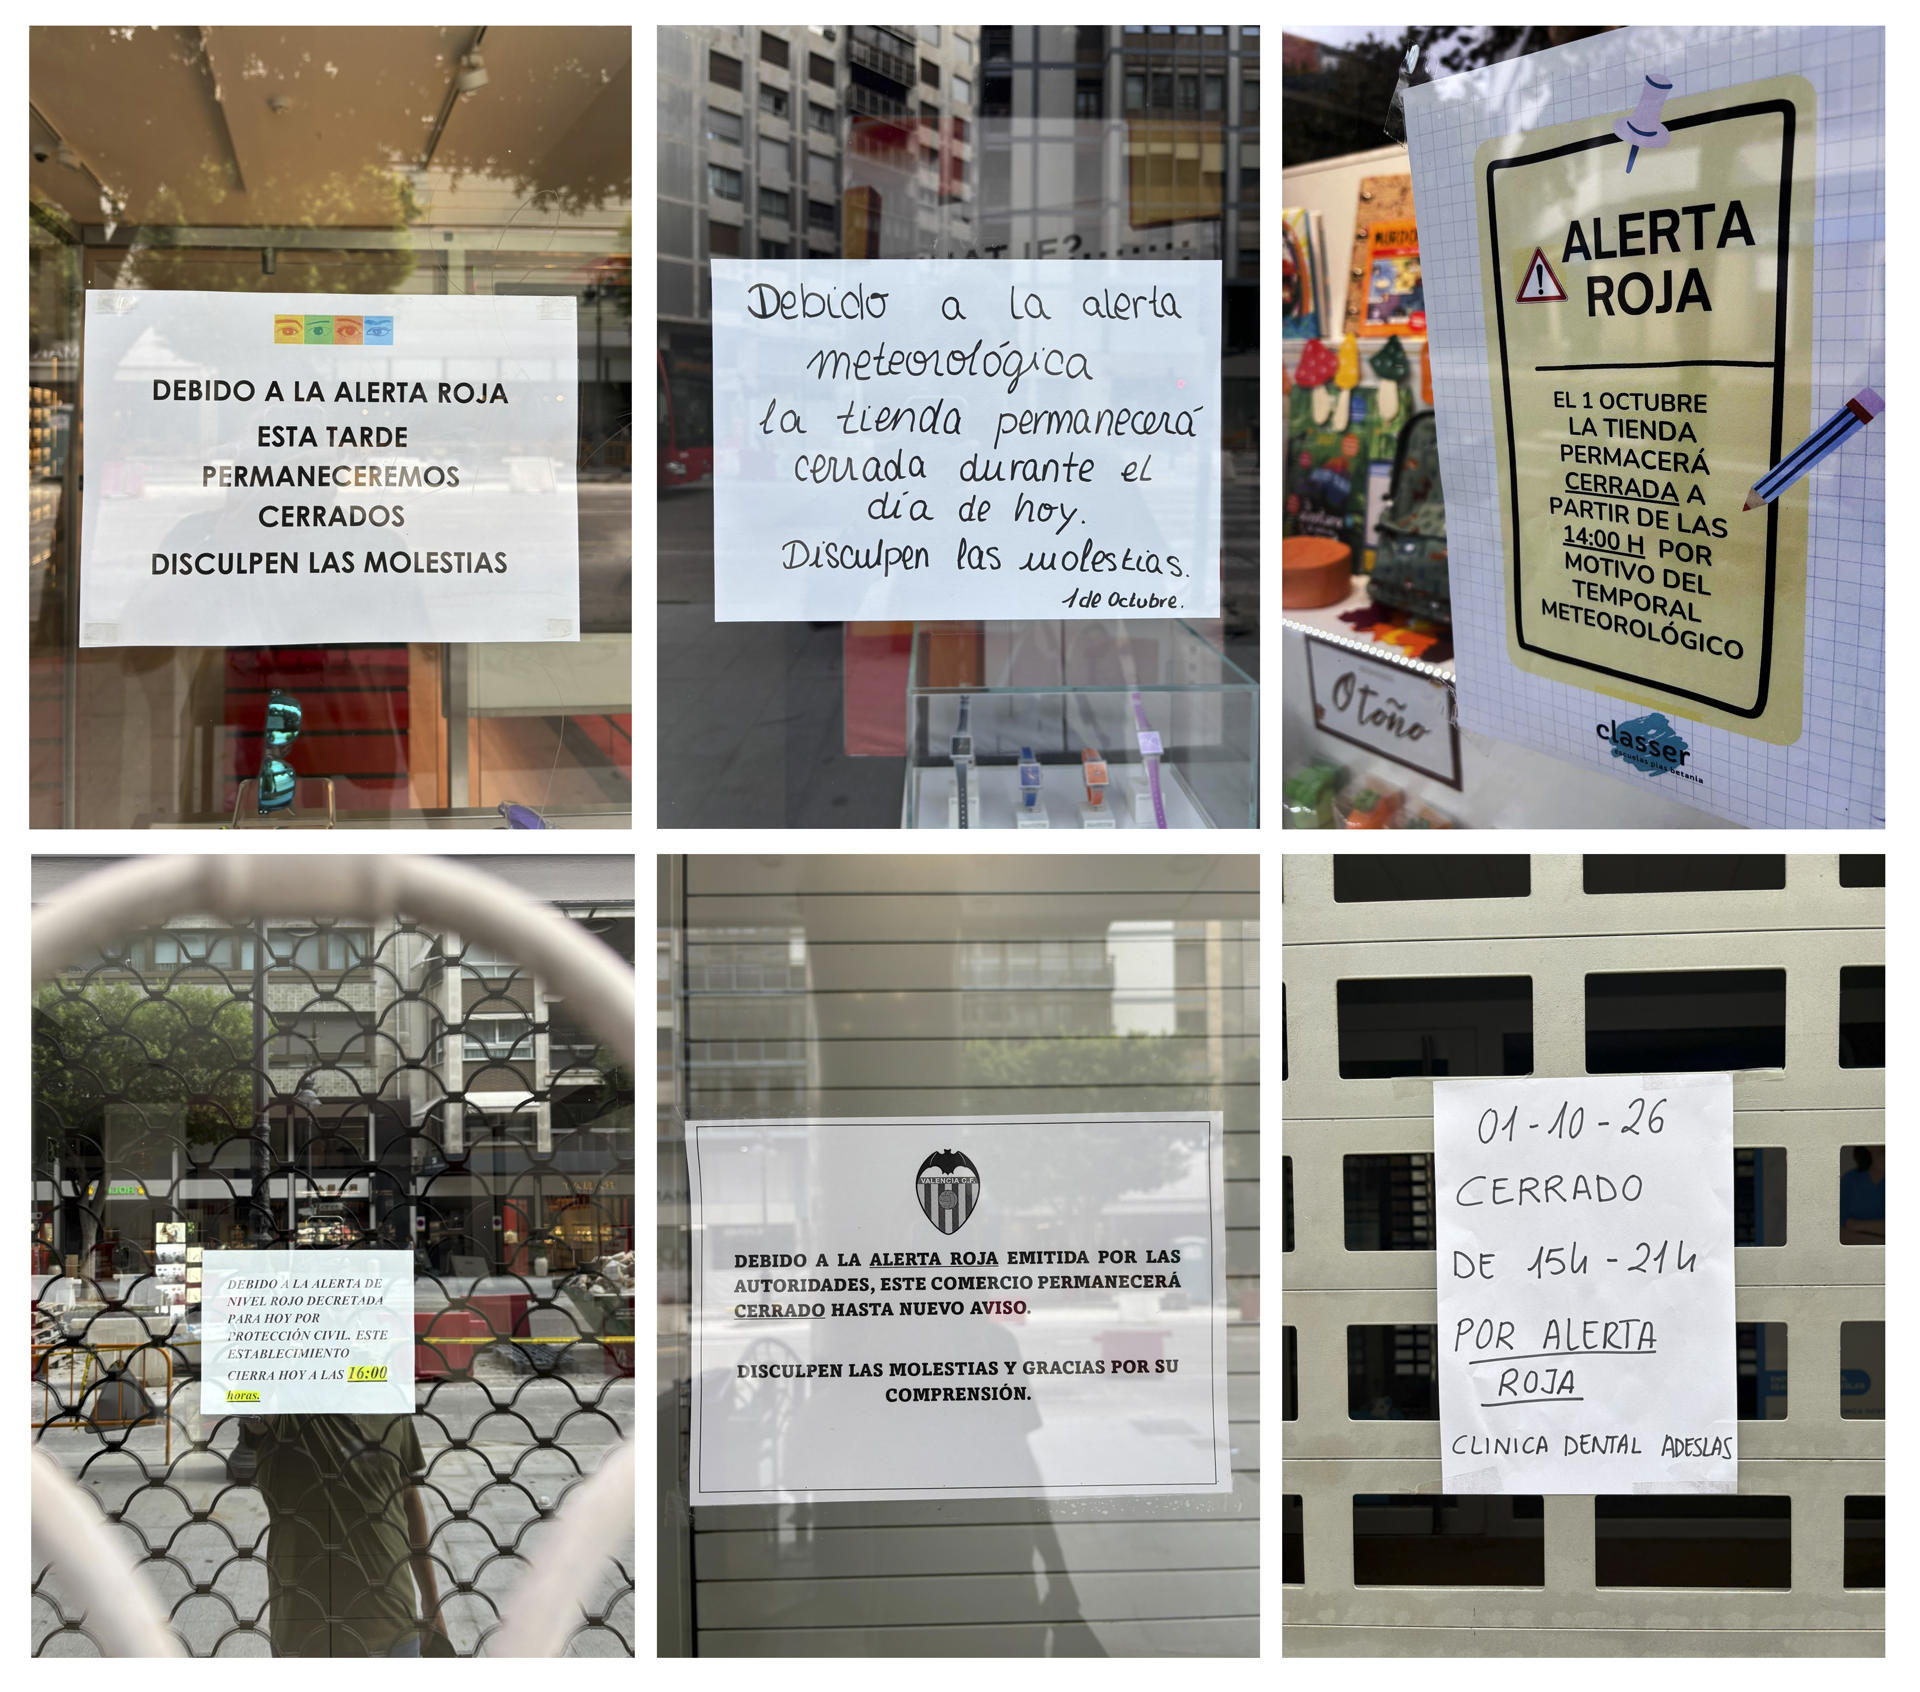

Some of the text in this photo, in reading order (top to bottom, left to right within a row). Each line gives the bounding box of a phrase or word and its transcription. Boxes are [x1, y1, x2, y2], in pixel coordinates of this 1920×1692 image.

[1562, 200, 1756, 263] ALERTA
[747, 282, 1182, 320] Debido a la alerta
[1587, 268, 1712, 317] ROJA
[806, 339, 1093, 393] meteorológica
[152, 379, 509, 404] DEBIDO A LA ALERTA ROJA
[1554, 391, 1707, 414] EL 1 OCTUBRE
[258, 425, 408, 448] ESTA TARDE
[759, 398, 1204, 450] la tienda permanecerá
[1569, 417, 1697, 443] LA TIENDA
[794, 448, 927, 483] cerrada
[960, 452, 1095, 482] durante
[1560, 444, 1710, 475] PERMACERÁ
[202, 465, 460, 488] PERMANECEREMOS
[1565, 472, 1706, 505] CERRADA A
[258, 505, 405, 527] CERRADOS
[868, 491, 1086, 535] día de hoy.
[1550, 497, 1729, 539] PARTIR DE LAS
[782, 538, 929, 577] Disculpen
[956, 537, 1002, 570] las
[1564, 525, 1712, 566] 14:00 H POR
[151, 551, 508, 575] DISCULPEN LAS MOLESTIAS
[1565, 551, 1712, 596] MOTIVO DEL
[1107, 591, 1185, 609] Octubre.
[1572, 579, 1702, 623] TEMPORAL
[1541, 598, 1744, 660] METEOROLÓGICO
[1332, 671, 1432, 741] Otoño
[1596, 720, 1690, 766] classer
[1670, 767, 1704, 784] betania
[1456, 1174, 1643, 1206] CERRADO
[734, 1250, 1181, 1268] DEBIDO A LA ALERTA ROJA EMITIDA POR LAS
[1453, 1250, 1495, 1279] DE
[227, 1279, 383, 1289] DEBIDO A LA ALERTA DE
[734, 1272, 1181, 1294] AUTORIDADES, ESTE COMERCIO PERMANECERÁ
[227, 1295, 384, 1307] NIVEL ROJO DECRETADA
[734, 1300, 1031, 1318] CERRADO HASTA NUEVO AVISO.
[228, 1313, 320, 1324] PARA HOY POR
[228, 1328, 389, 1341] PROTECCIÓN CIVIL. ESTE
[1455, 1318, 1657, 1351] POR ALERTA
[227, 1348, 350, 1359] ESTABLECIMIENTO
[227, 1366, 388, 1380] CIERRA HOY A LAS 16:00
[737, 1359, 1178, 1378] DISCULPEN LAS MOLESTIAS Y GRACIAS POR SU
[227, 1391, 260, 1400] horas.
[885, 1384, 1031, 1402] COMPRENSIÓN.
[1499, 1369, 1575, 1396] ROJA
[1451, 1434, 1732, 1459] CLINICA DENTAL ADESLAS
